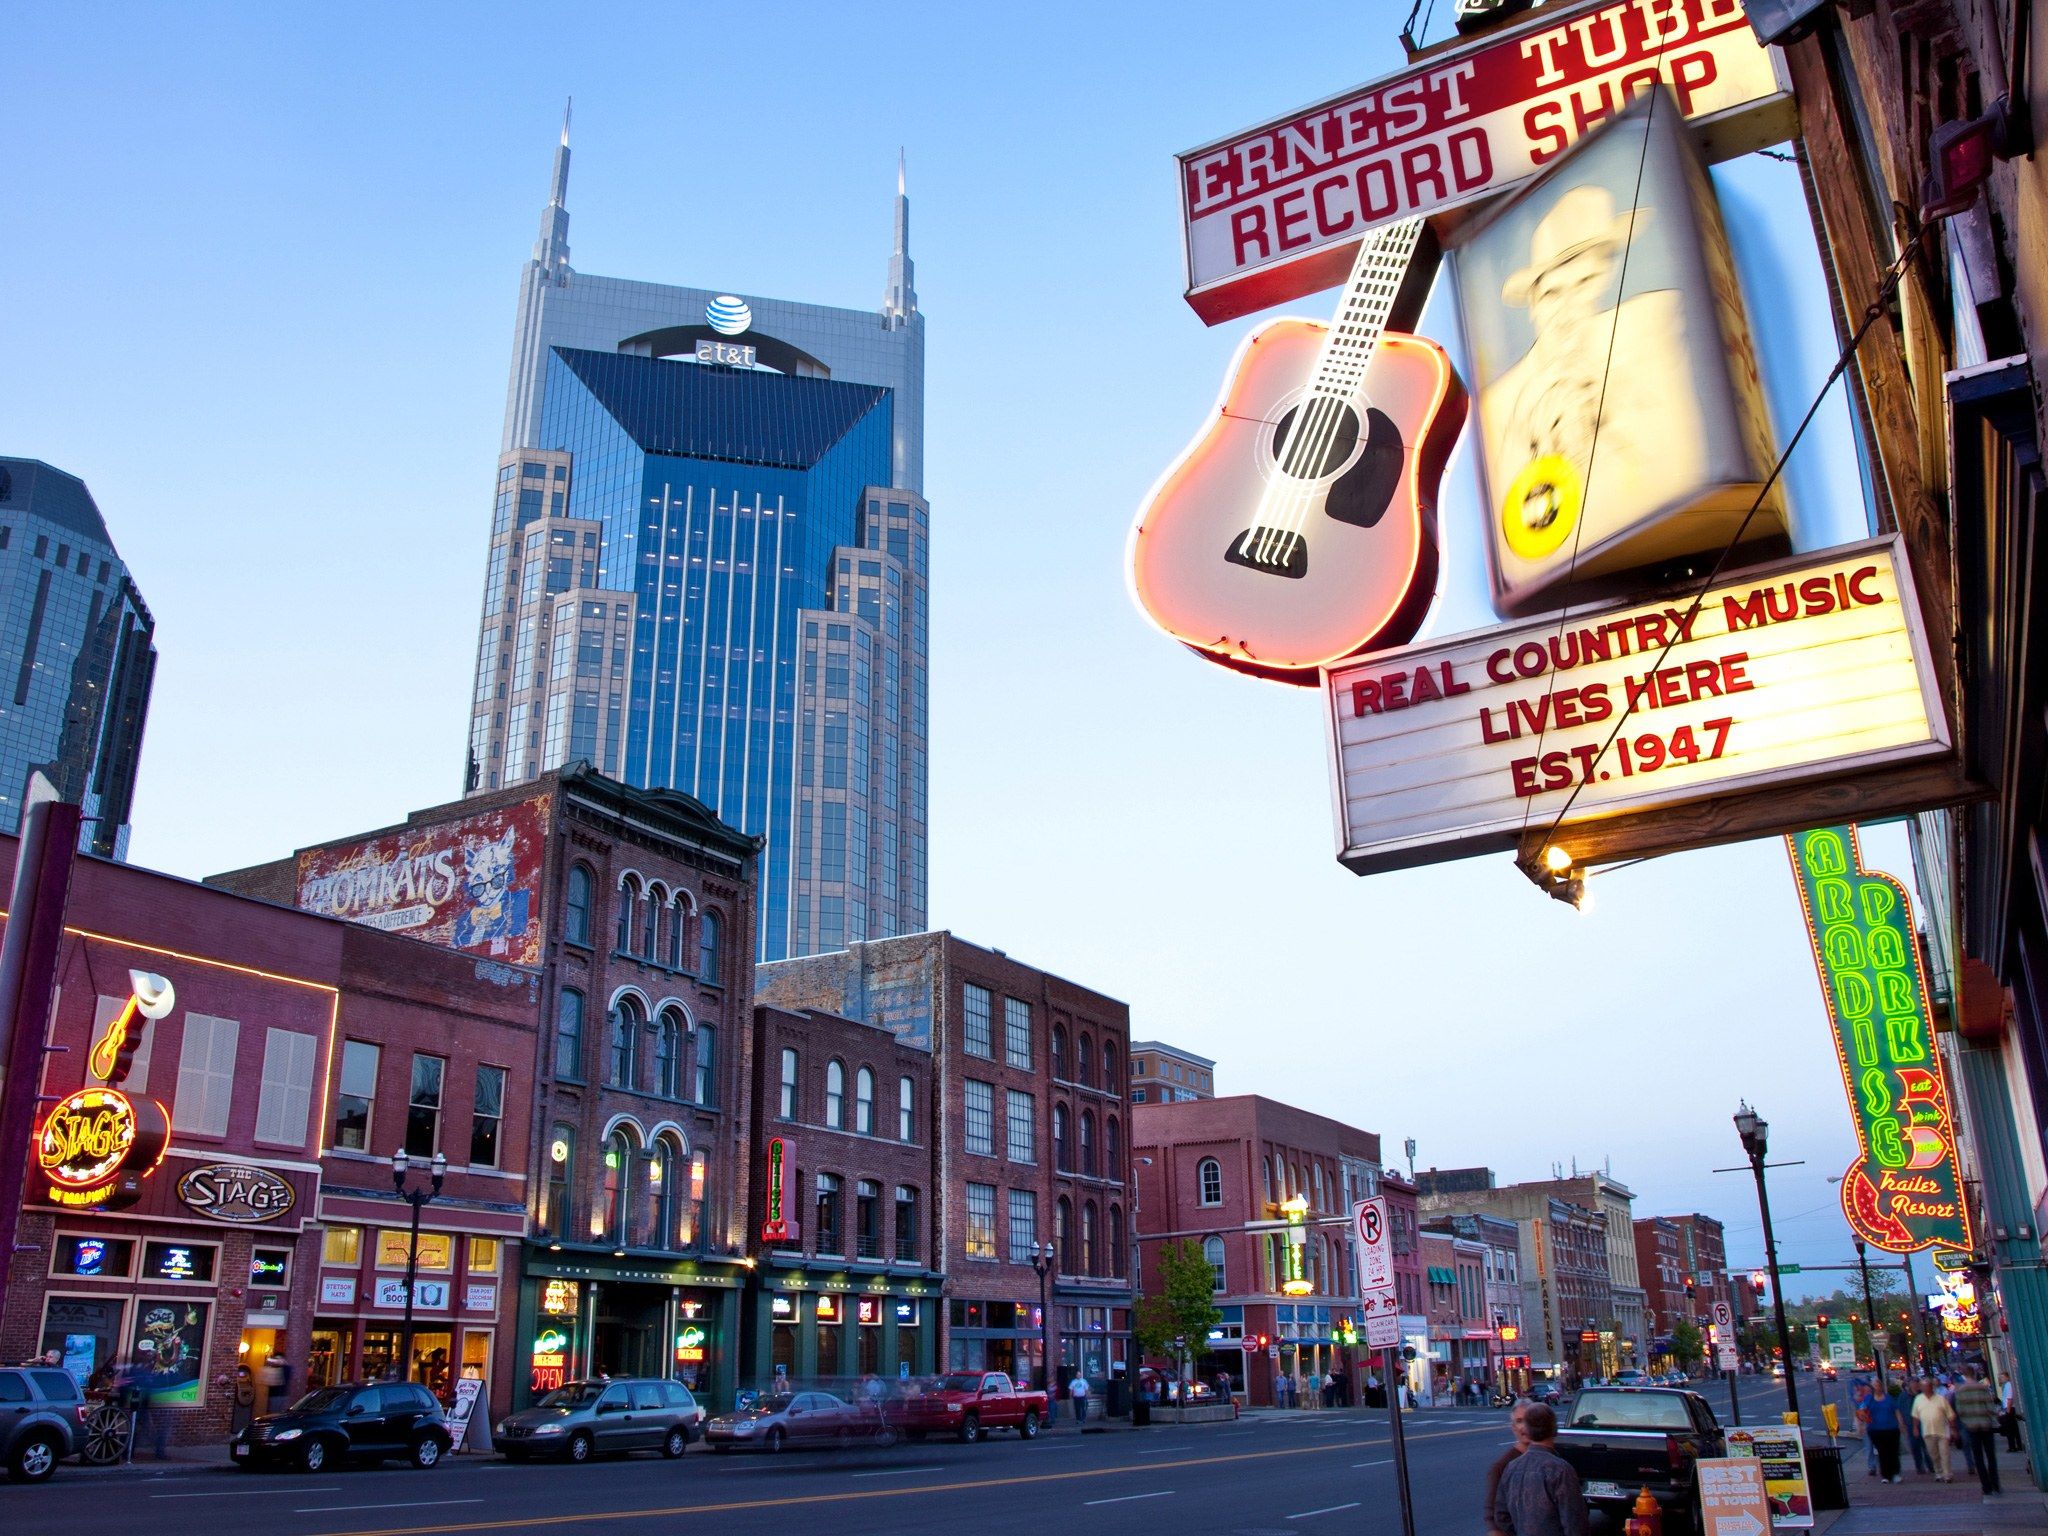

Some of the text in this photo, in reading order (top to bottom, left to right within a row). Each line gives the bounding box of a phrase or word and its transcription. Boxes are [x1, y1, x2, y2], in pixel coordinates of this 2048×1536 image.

[1191, 61, 1475, 212] ERNEST
[1231, 128, 1493, 266] RECORD
[697, 342, 754, 366] at&t
[1352, 566, 1883, 717] REAL COUNTRY MUSIC
[1479, 653, 1755, 746] LIVES HERE
[383, 908, 423, 929] DIFFERENCE
[1859, 882, 1925, 1062] PARK
[1806, 828, 1906, 1168] ARADISE
[40, 1106, 129, 1168] STAGE
[230, 1168, 251, 1179] THE
[1879, 1169, 1942, 1195] Trailer
[185, 1169, 290, 1208] STAGE
[1891, 1195, 1955, 1218] Resort
[383, 1285, 396, 1296] BIG
[148, 1312, 174, 1324] STAGE
[1541, 1278, 1554, 1351] PARKING
[531, 1368, 564, 1391] OPEN
[1701, 1466, 1758, 1484] BEST
[1703, 1482, 1759, 1495] BURGER
[1705, 1495, 1760, 1507] IN TOWN
